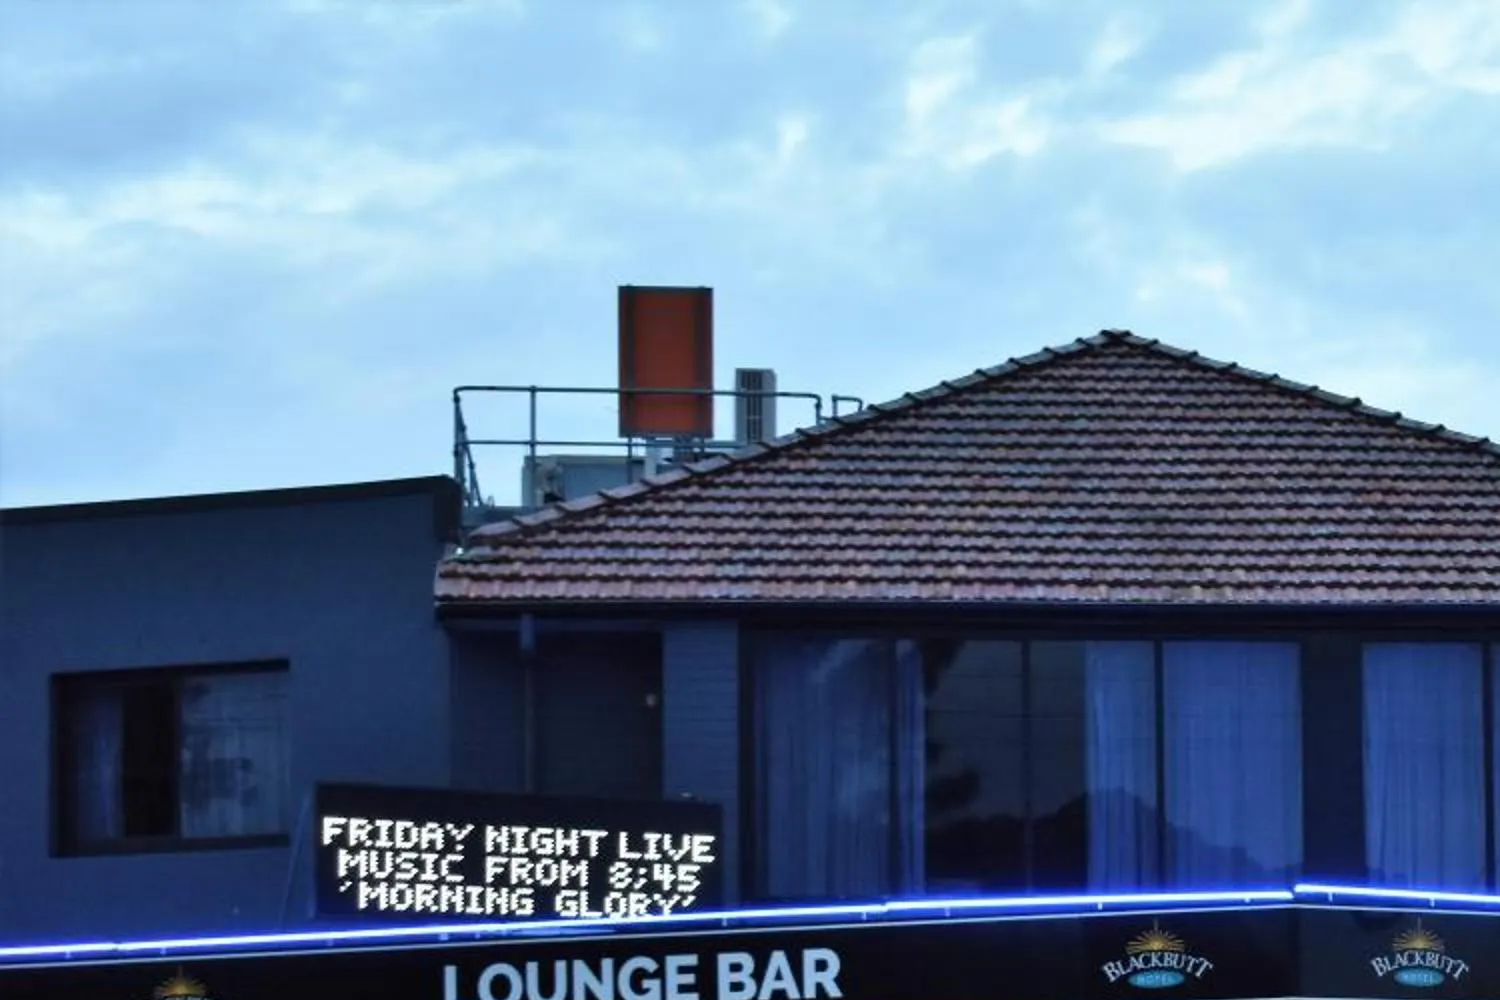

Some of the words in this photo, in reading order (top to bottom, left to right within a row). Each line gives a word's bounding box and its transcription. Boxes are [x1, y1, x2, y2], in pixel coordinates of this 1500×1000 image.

[322, 816, 475, 851] FRIDAY
[485, 825, 609, 858] NIGHT
[619, 831, 716, 863] LIVE
[337, 848, 465, 882] MUSIC
[485, 855, 590, 887] FROM
[1102, 951, 1214, 982] BLACKBUTT
[1370, 950, 1470, 979] BLACKBUTT
